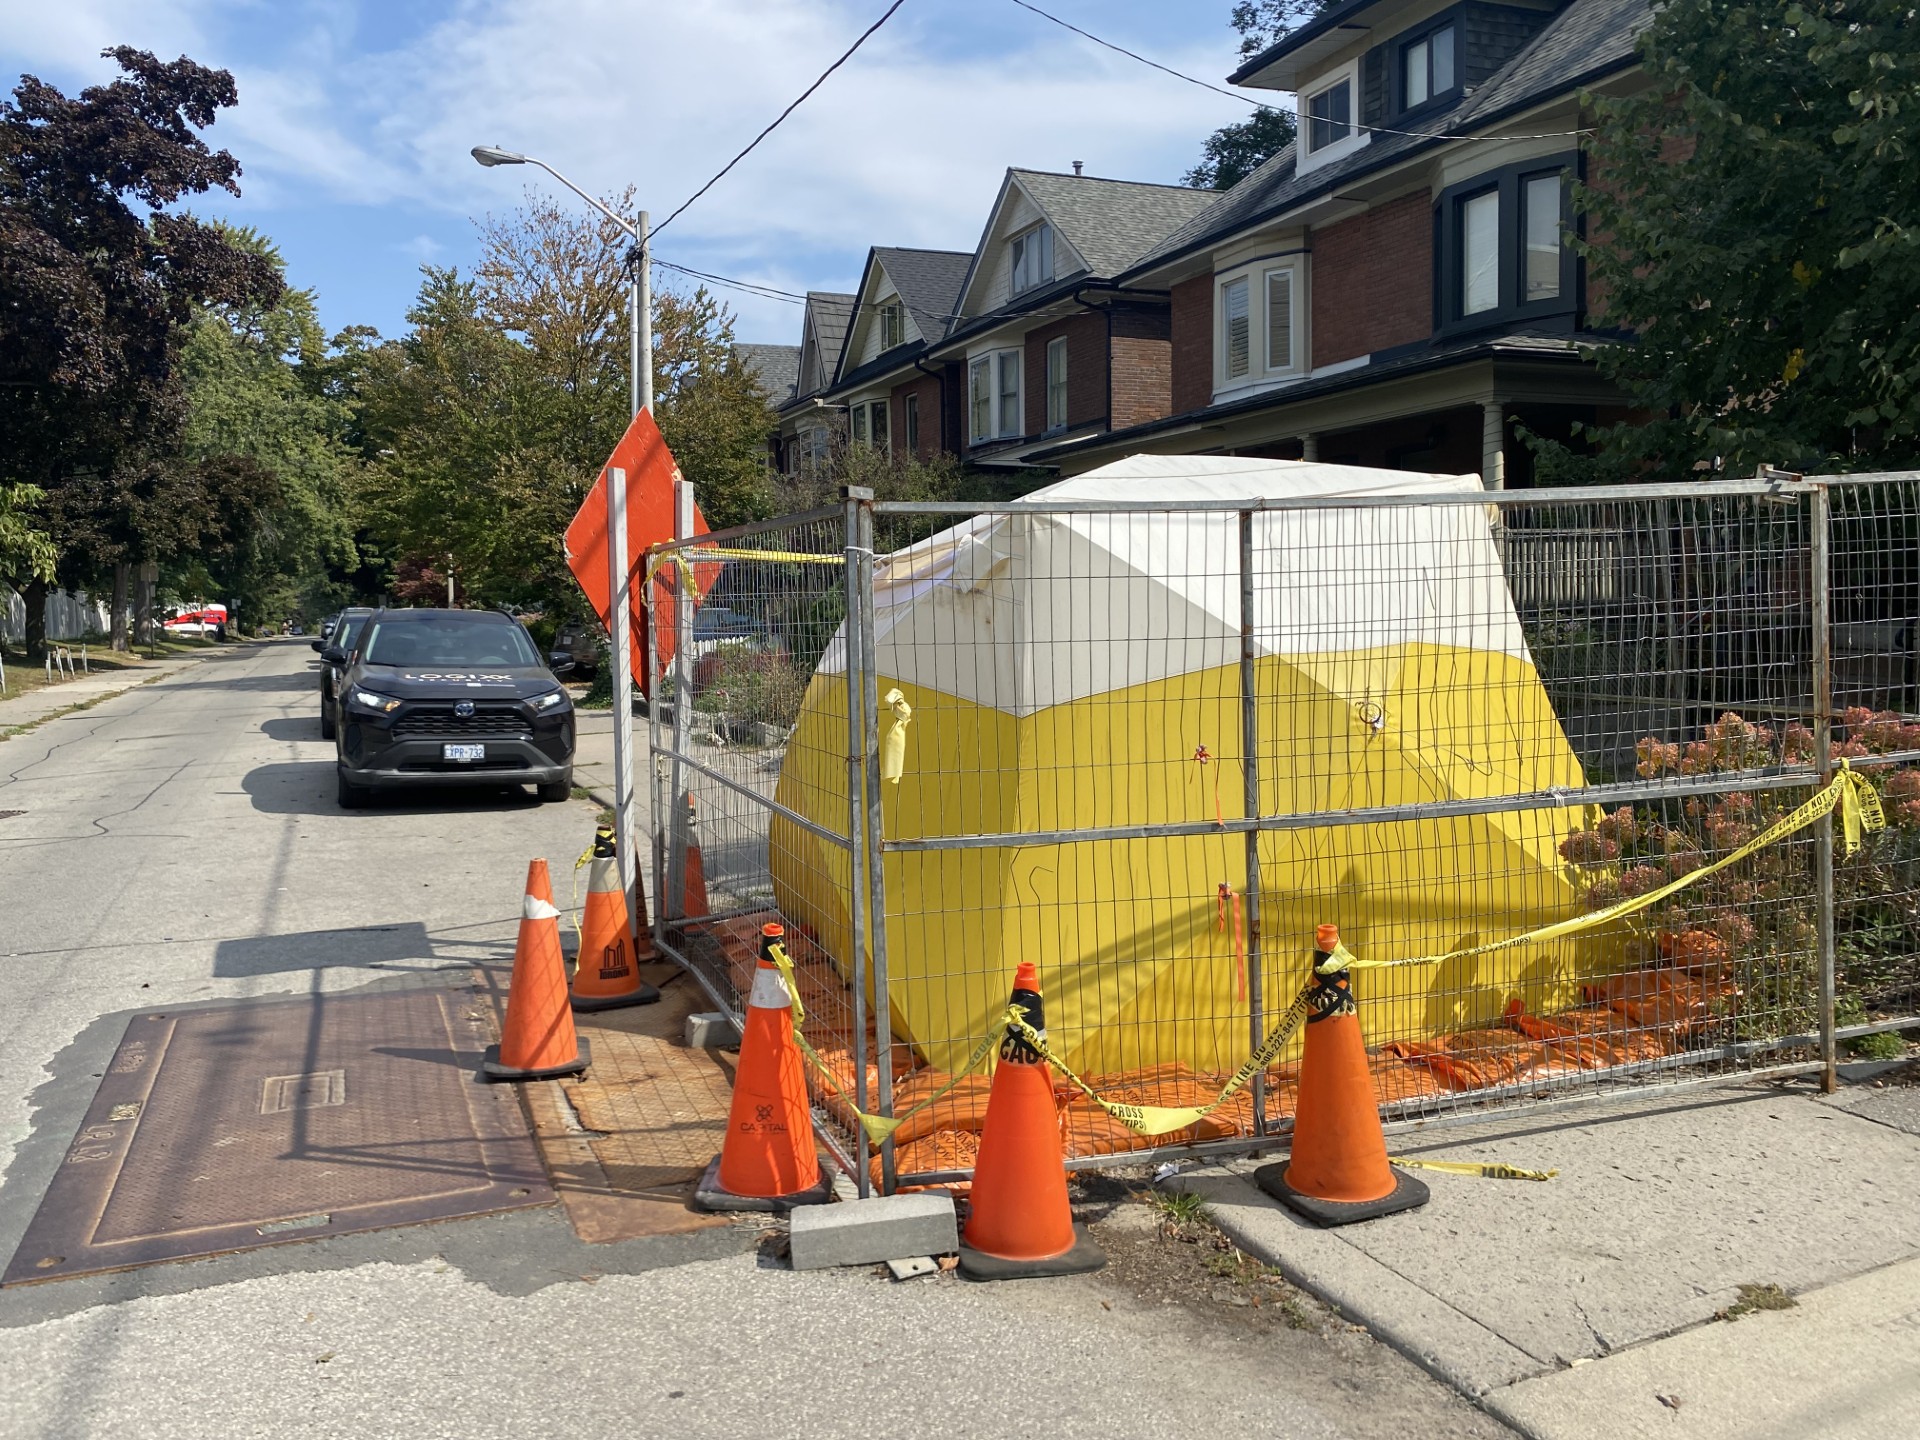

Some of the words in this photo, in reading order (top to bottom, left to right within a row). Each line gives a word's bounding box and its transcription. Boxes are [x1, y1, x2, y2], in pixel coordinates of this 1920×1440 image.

[1747, 827, 1775, 851] POLICE
[1778, 815, 1796, 831] LINE
[1798, 804, 1809, 817] DO
[1811, 792, 1827, 809] NOT
[1110, 1105, 1144, 1119] CROSS
[740, 1122, 789, 1132] CAPTAL
